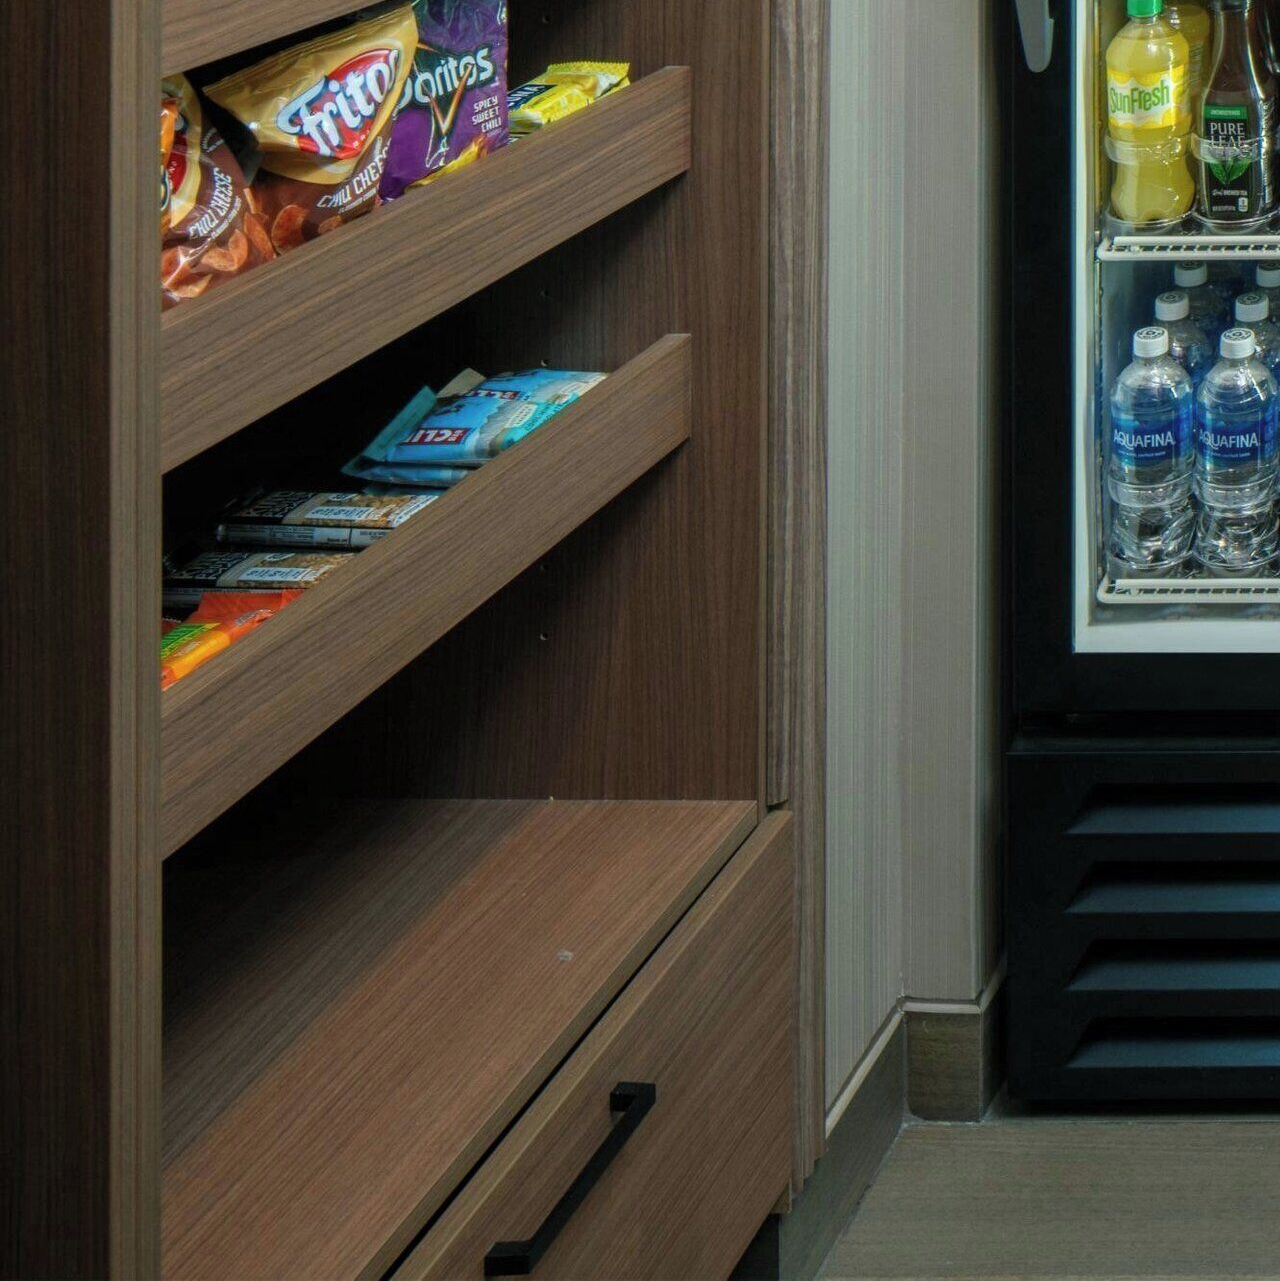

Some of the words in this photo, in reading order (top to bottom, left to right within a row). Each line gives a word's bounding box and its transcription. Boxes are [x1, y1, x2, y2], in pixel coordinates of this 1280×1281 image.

[473, 95, 498, 113] SPICY
[472, 107, 500, 126] SWEET
[1210, 122, 1245, 135] PURE
[1113, 431, 1174, 449] AQUAFINA
[1200, 431, 1259, 449] AQUAFINA
